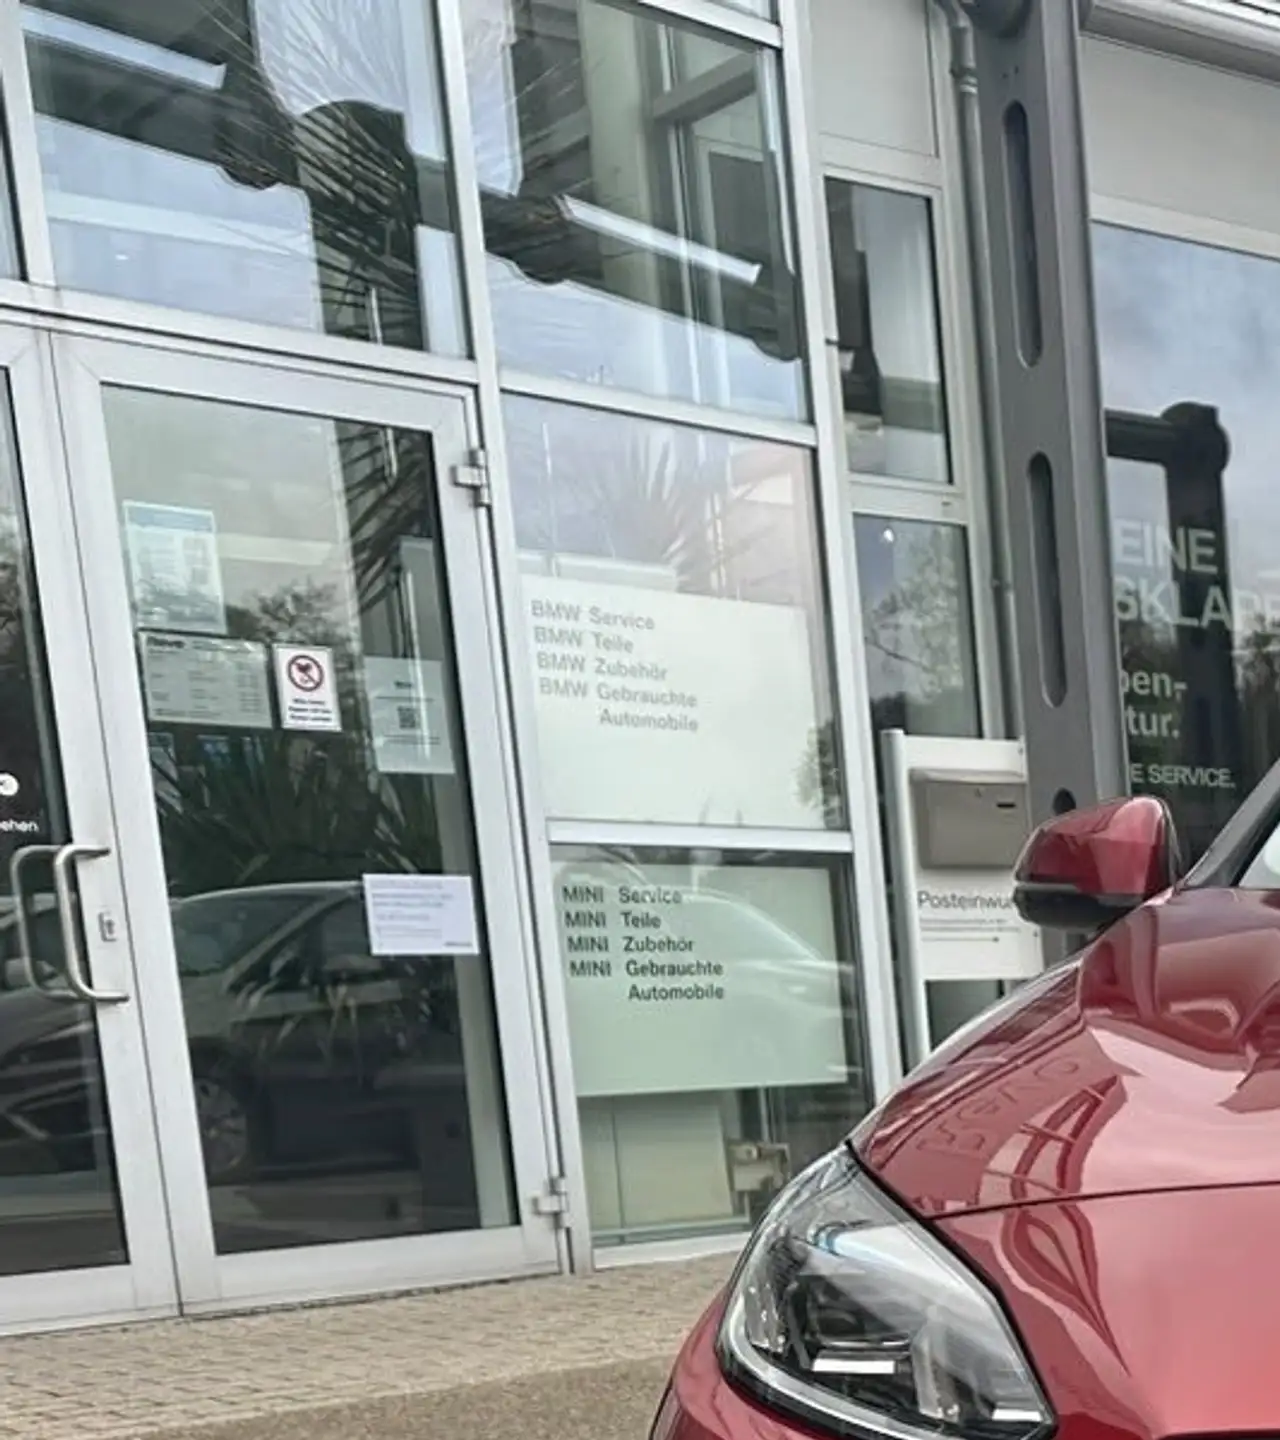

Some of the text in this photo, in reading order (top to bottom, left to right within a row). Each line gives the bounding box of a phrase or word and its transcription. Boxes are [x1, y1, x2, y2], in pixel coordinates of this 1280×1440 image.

[531, 600, 655, 630] BMW Service
[534, 626, 634, 653] BMW Teile
[536, 651, 668, 681] BMW Zubehör
[539, 677, 698, 708] BMW Gebrauchte
[600, 708, 699, 733] Automobile
[1148, 764, 1236, 788] SERVICE.
[562, 886, 683, 905] MINI Service
[564, 911, 662, 930] MINI Teile
[567, 936, 610, 952] MINI
[569, 959, 725, 977] MINI Gebrauchte
[628, 983, 726, 1001] Automobile
